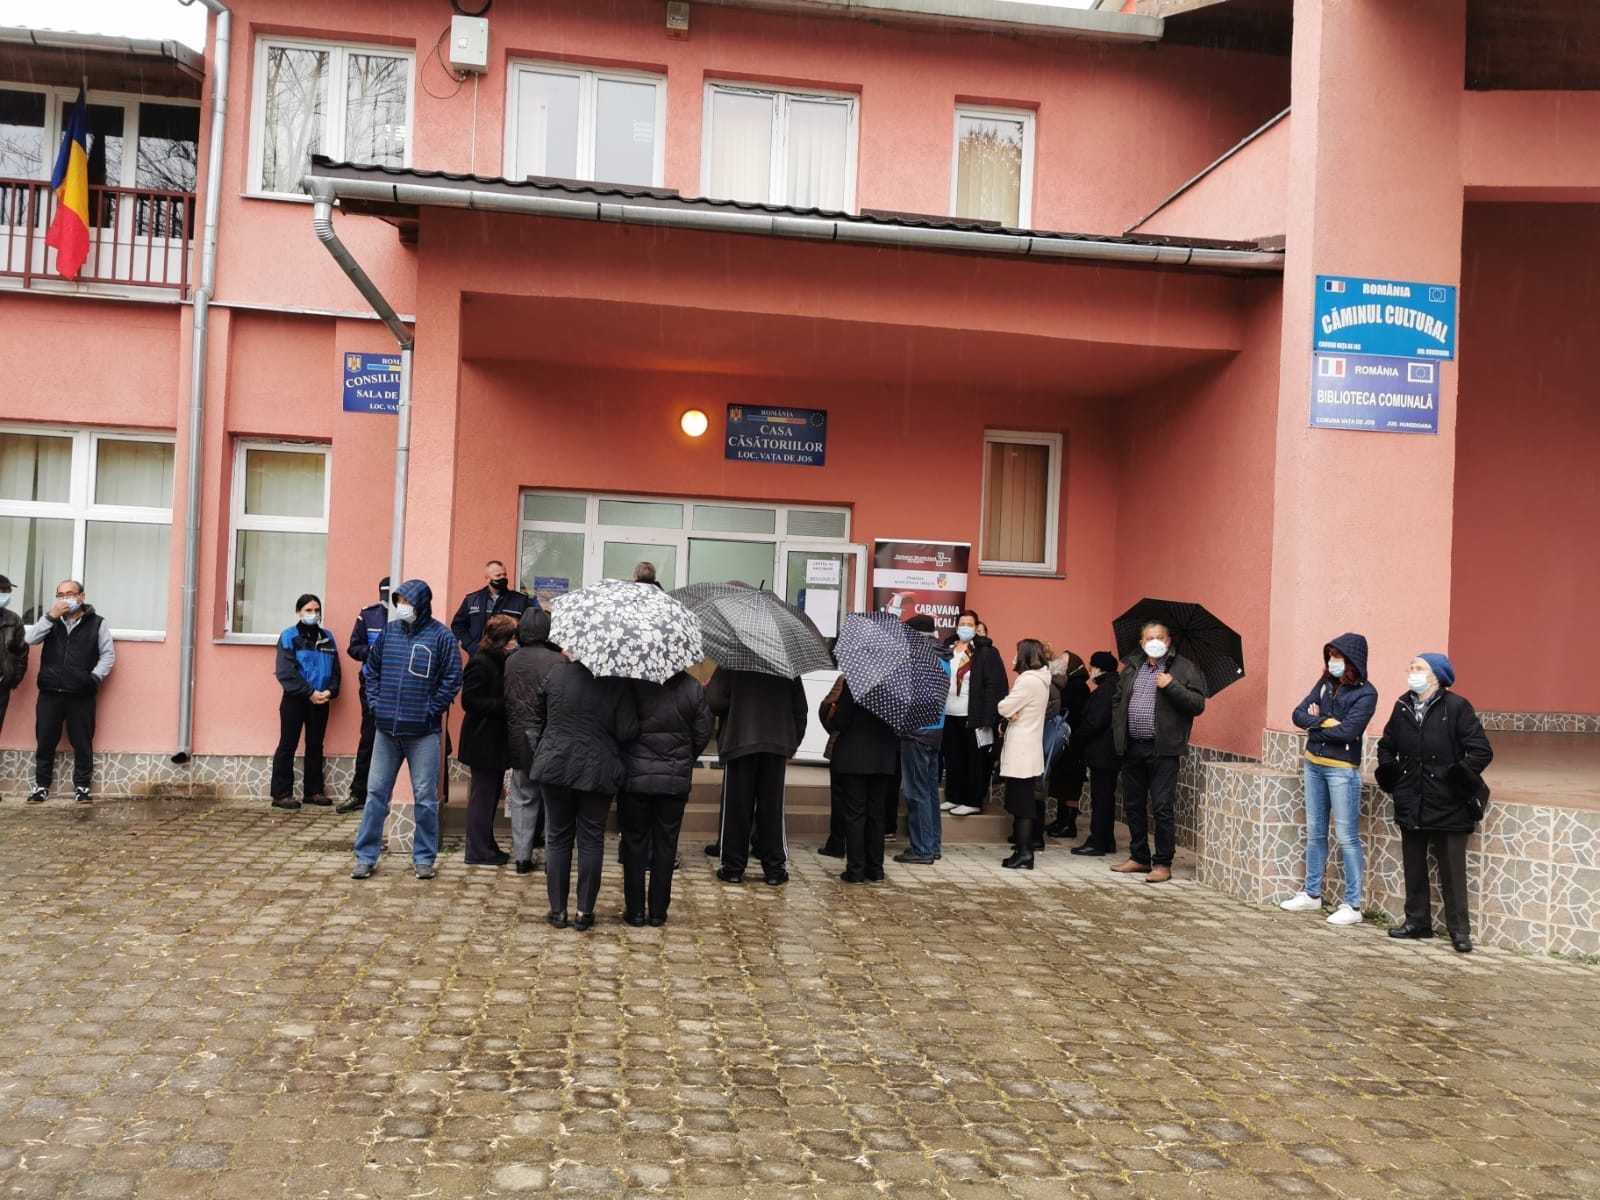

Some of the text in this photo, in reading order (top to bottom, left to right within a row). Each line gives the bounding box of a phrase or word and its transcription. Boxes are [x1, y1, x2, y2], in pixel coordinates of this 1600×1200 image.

[1362, 282, 1411, 298] ROMÂNIA
[1321, 303, 1449, 344] CĂMINUL CULTURAL
[1354, 364, 1399, 377] ROMÂNIA
[356, 389, 398, 400] SALA DE
[1317, 389, 1433, 409] BIBLIOTECA COMUNALĂ
[761, 409, 794, 417] ROMÂNIA
[760, 424, 793, 437] CASA
[728, 435, 824, 453] CĂSĂTORIILOR
[737, 450, 758, 459] LOC.
[783, 454, 796, 462] DE
[797, 455, 813, 463] JOS
[914, 603, 960, 615] CARAVANA
